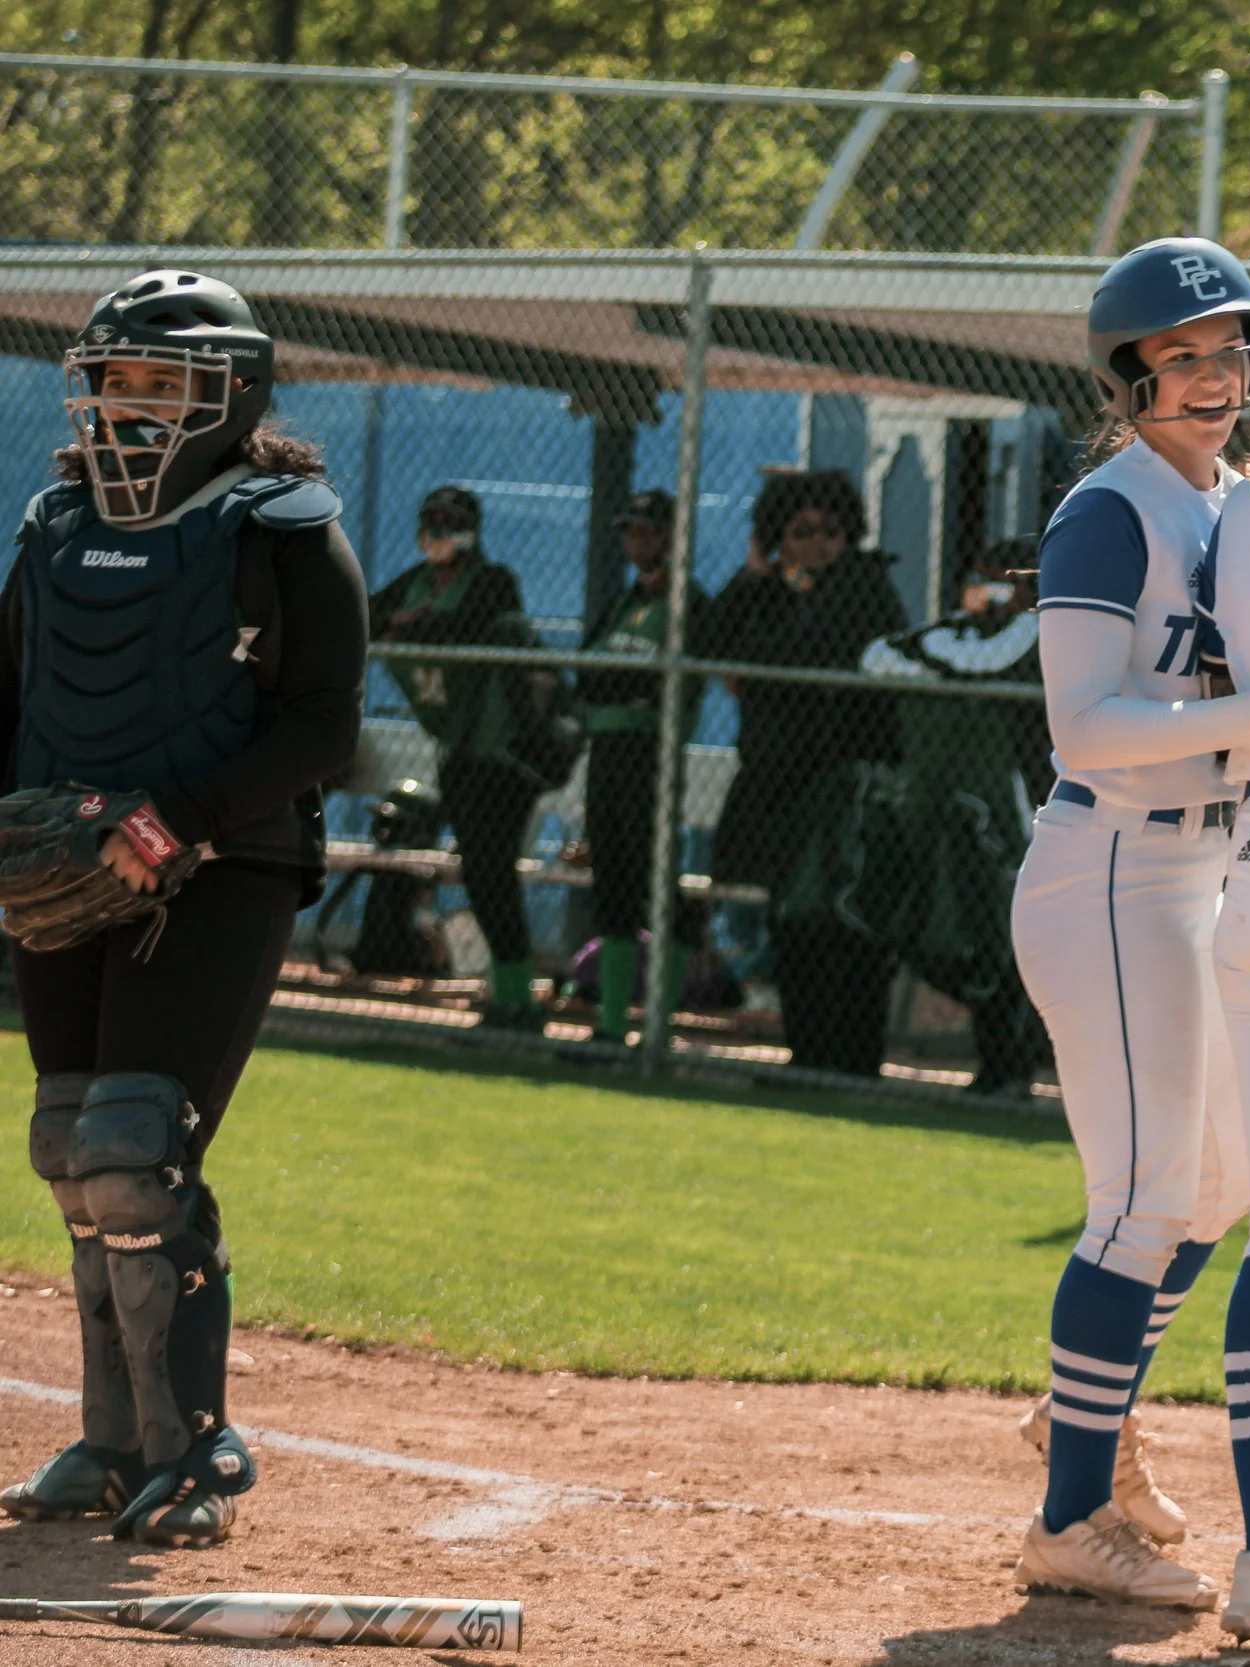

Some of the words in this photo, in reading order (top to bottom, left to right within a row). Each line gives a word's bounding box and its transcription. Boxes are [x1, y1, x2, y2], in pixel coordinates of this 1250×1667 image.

[81, 549, 148, 568] Wilson
[131, 816, 171, 855] Rawlings
[104, 1233, 162, 1250] Wilson
